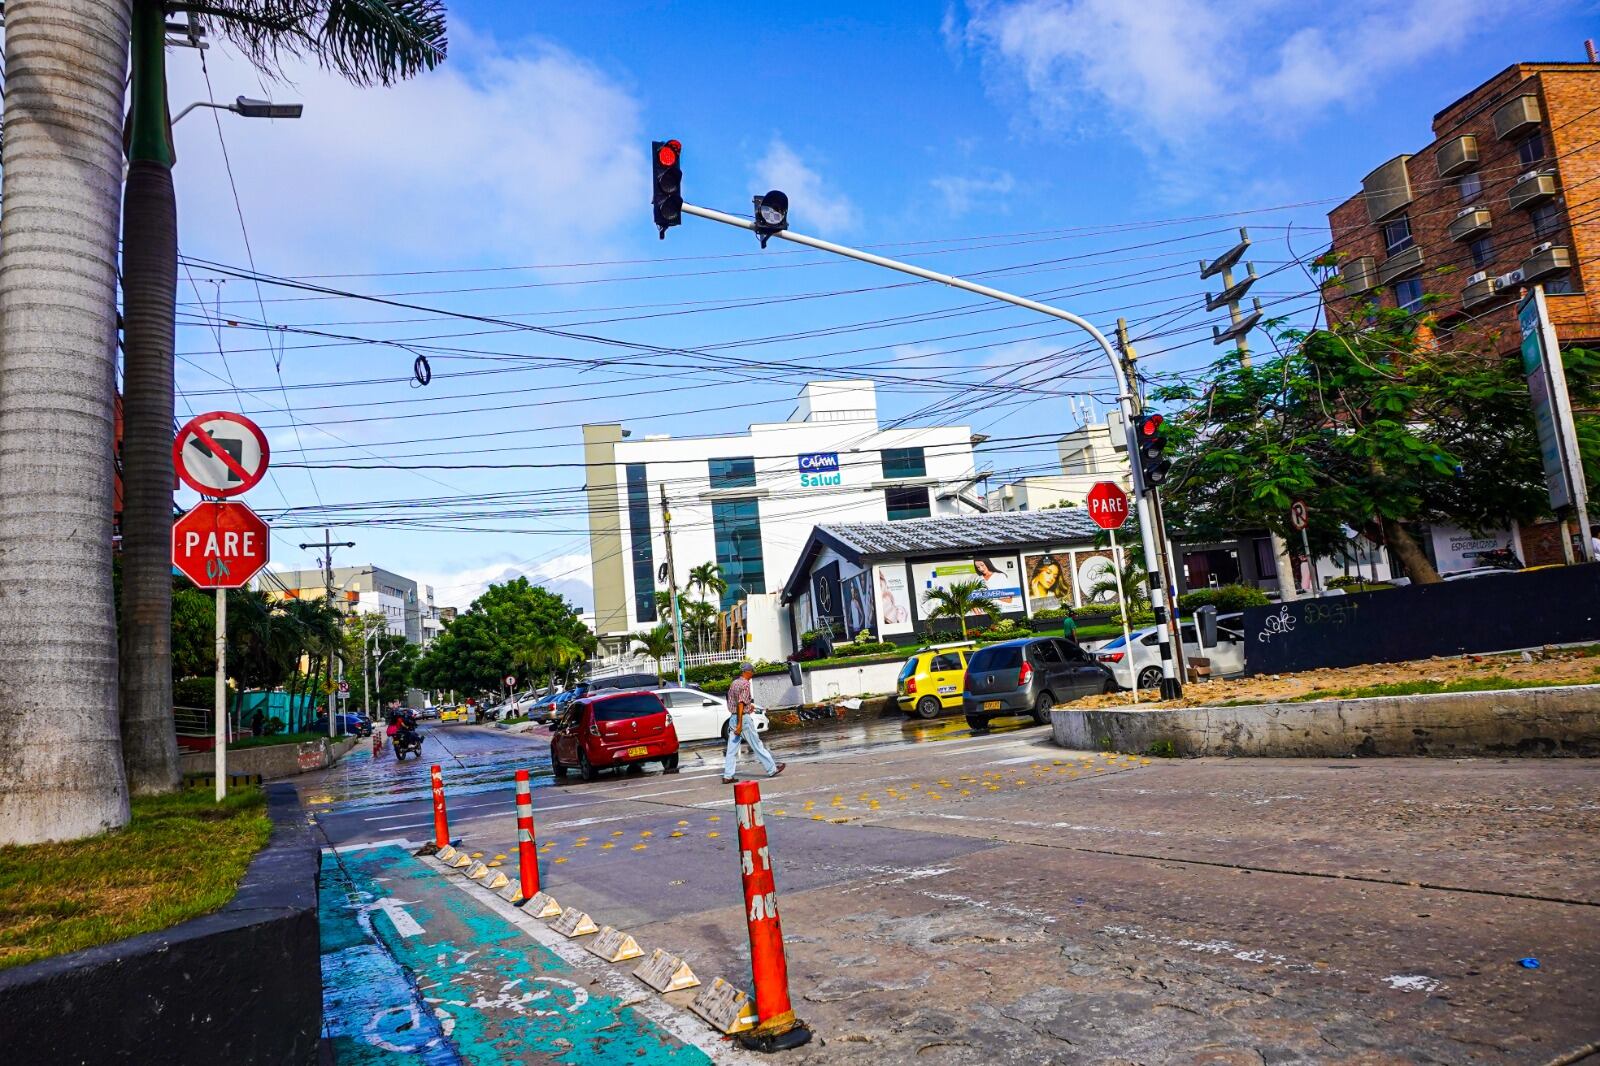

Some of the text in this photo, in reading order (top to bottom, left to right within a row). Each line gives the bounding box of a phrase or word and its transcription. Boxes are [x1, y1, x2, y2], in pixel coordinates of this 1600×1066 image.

[800, 472, 841, 487] Salud
[1092, 498, 1123, 513] PARE
[185, 531, 255, 557] PARE
